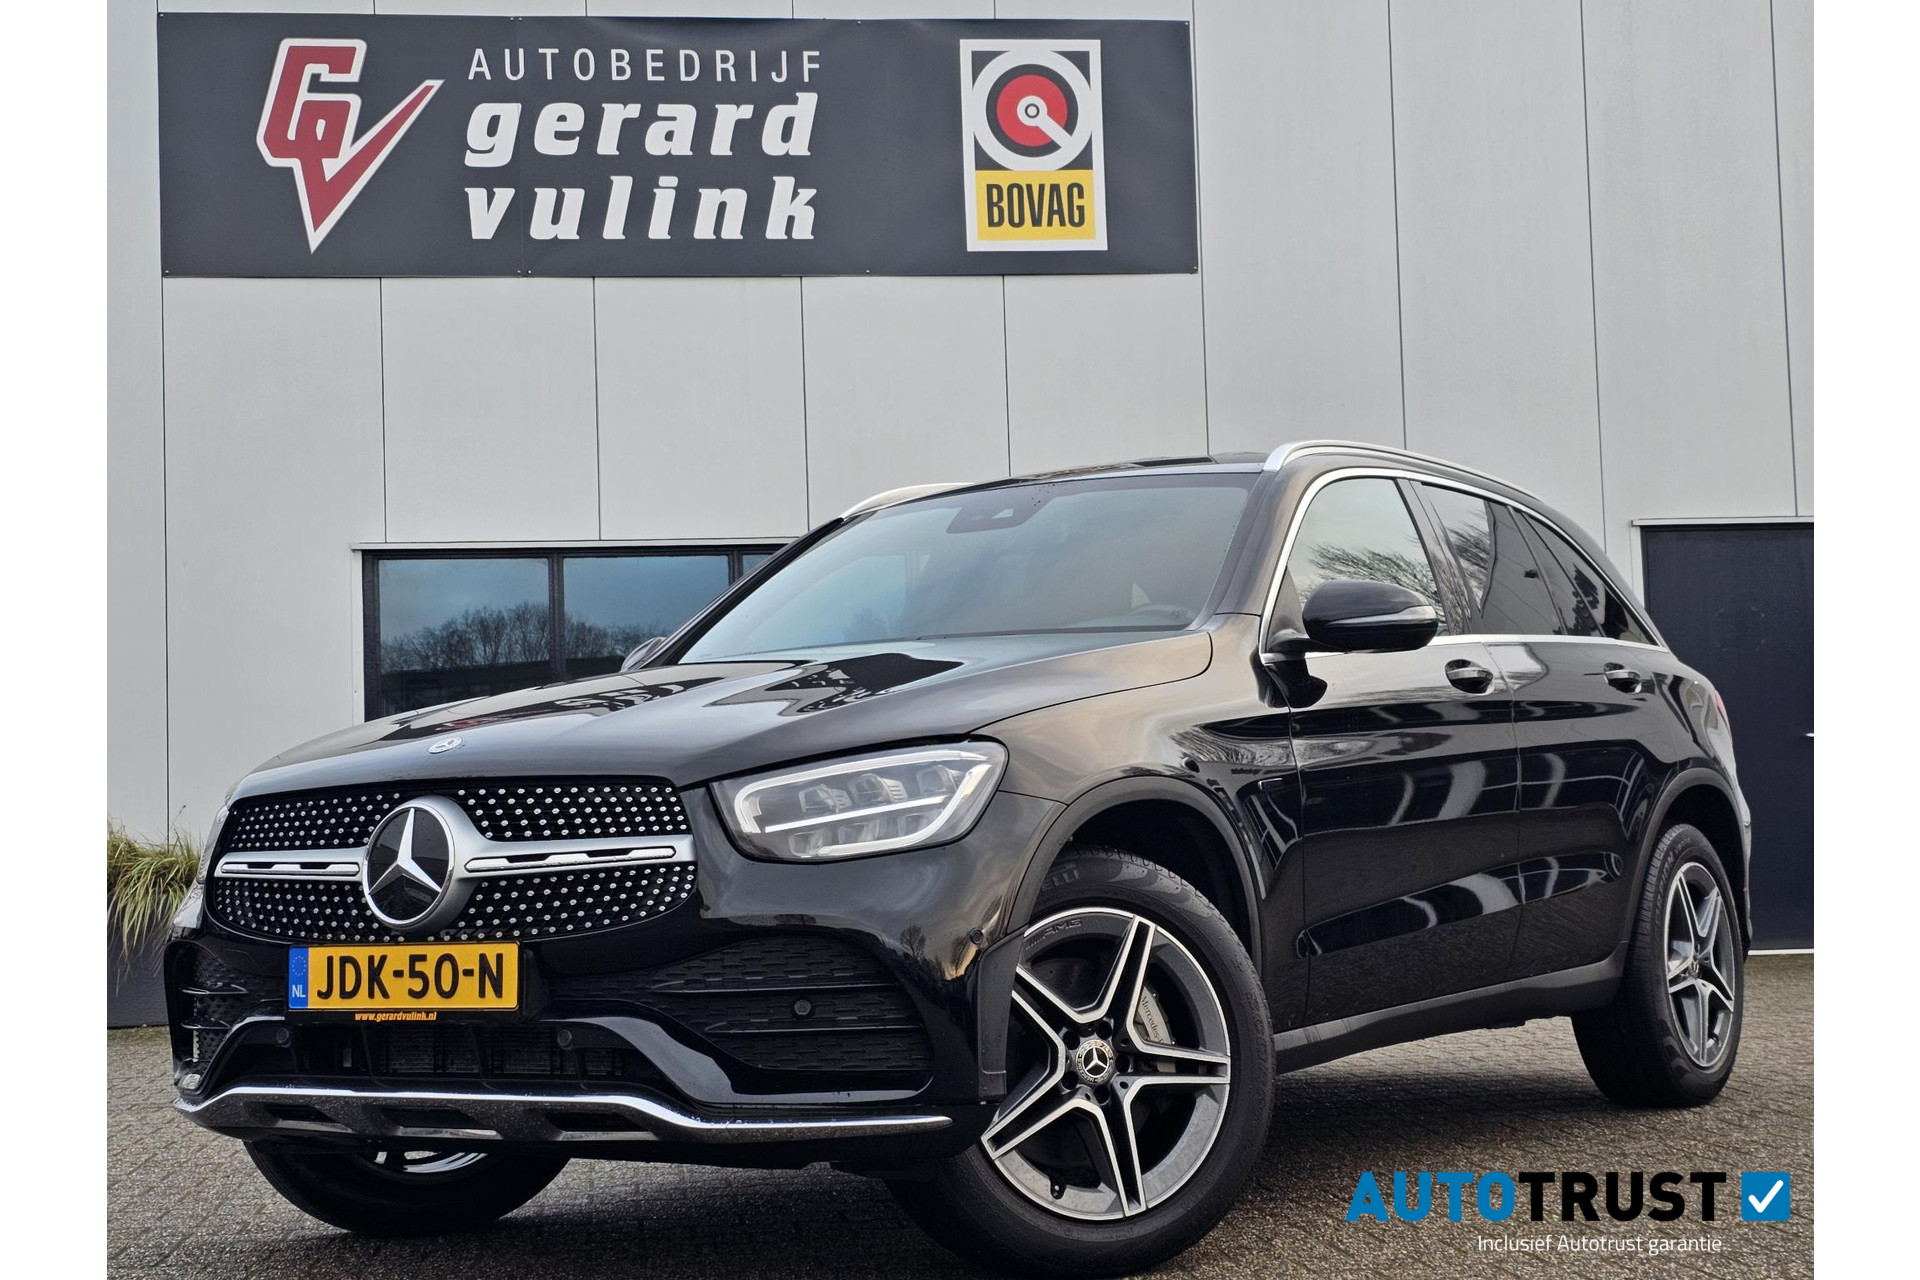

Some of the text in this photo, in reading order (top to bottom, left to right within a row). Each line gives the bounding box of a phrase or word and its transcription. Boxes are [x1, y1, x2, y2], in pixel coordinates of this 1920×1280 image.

[468, 48, 820, 83] AUTOBEDRIJF
[465, 92, 819, 168] gerard
[465, 176, 818, 240] vulink
[986, 182, 1086, 228] BOVAG
[292, 984, 306, 998] NL
[316, 952, 504, 1000] JDK-50-N
[354, 1011, 437, 1023] www.gerardvulink.nl
